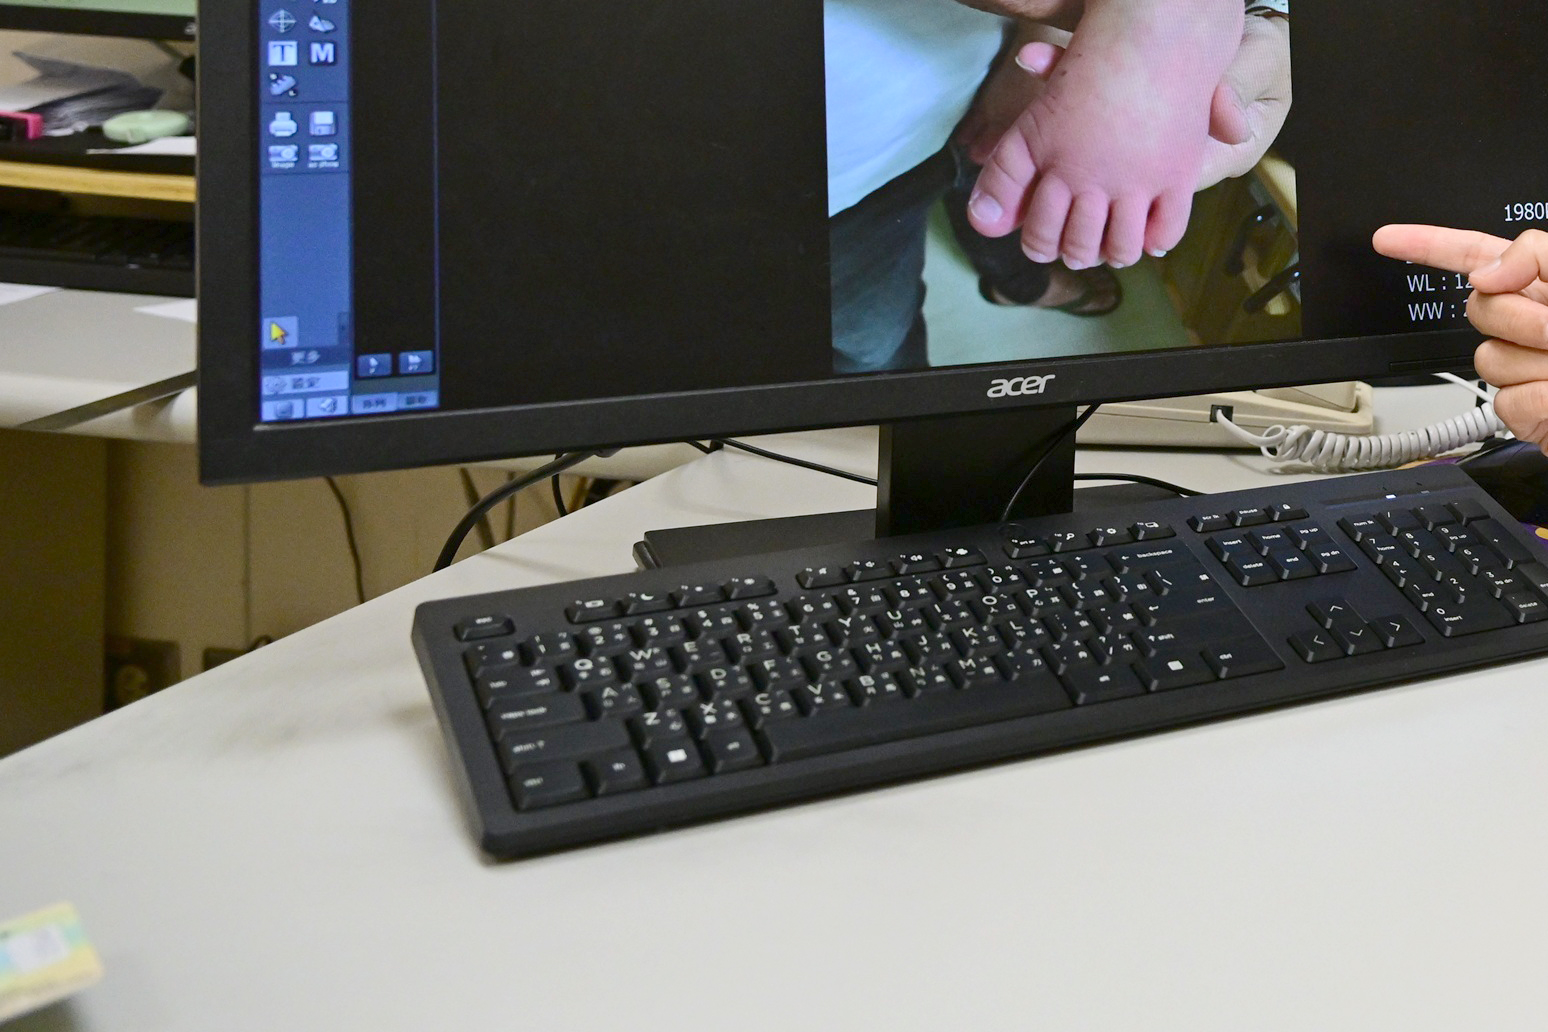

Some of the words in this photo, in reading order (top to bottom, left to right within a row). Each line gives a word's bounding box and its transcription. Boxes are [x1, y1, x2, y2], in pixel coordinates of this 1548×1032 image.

[310, 42, 335, 63] M
[1406, 274, 1436, 293] WL
[1408, 301, 1444, 321] WW
[986, 374, 1056, 398] acer
[1136, 549, 1174, 558] backspace
[1026, 589, 1038, 598] P
[788, 625, 801, 636] T
[962, 627, 978, 638] K
[736, 633, 752, 644] R
[918, 635, 928, 646] J
[683, 641, 699, 652] E
[864, 643, 882, 654] H
[629, 647, 653, 661] W
[574, 658, 594, 671] Q
[807, 683, 822, 696] V
[755, 693, 772, 705] C
[700, 702, 718, 716] X
[643, 711, 661, 725] Z
